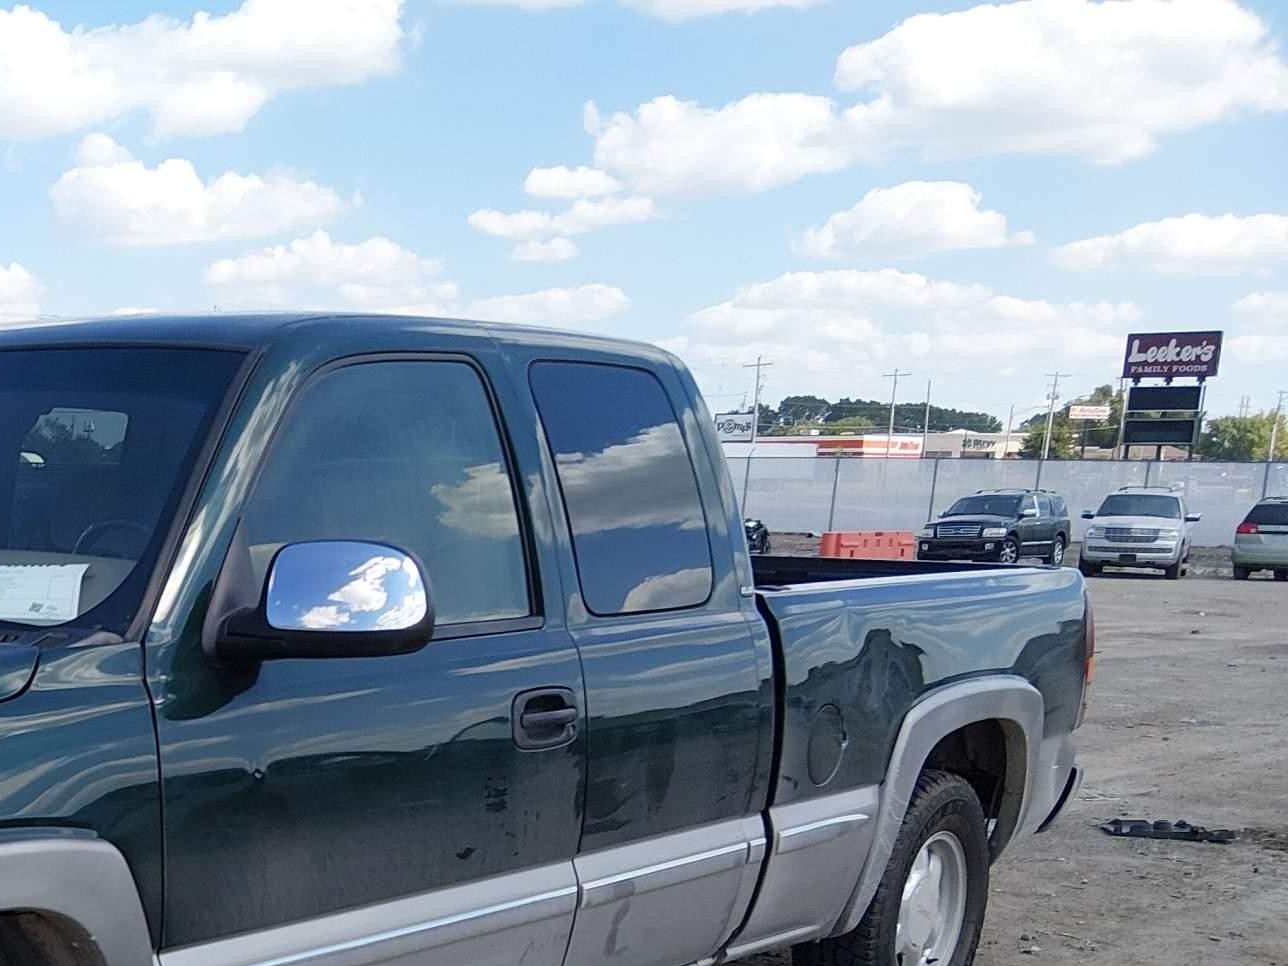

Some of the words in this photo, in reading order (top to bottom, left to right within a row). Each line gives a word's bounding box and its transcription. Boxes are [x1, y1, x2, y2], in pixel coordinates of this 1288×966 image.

[1128, 338, 1216, 363] Leeker's
[1130, 365, 1169, 373] FAMILY
[1172, 364, 1208, 373] FOODS
